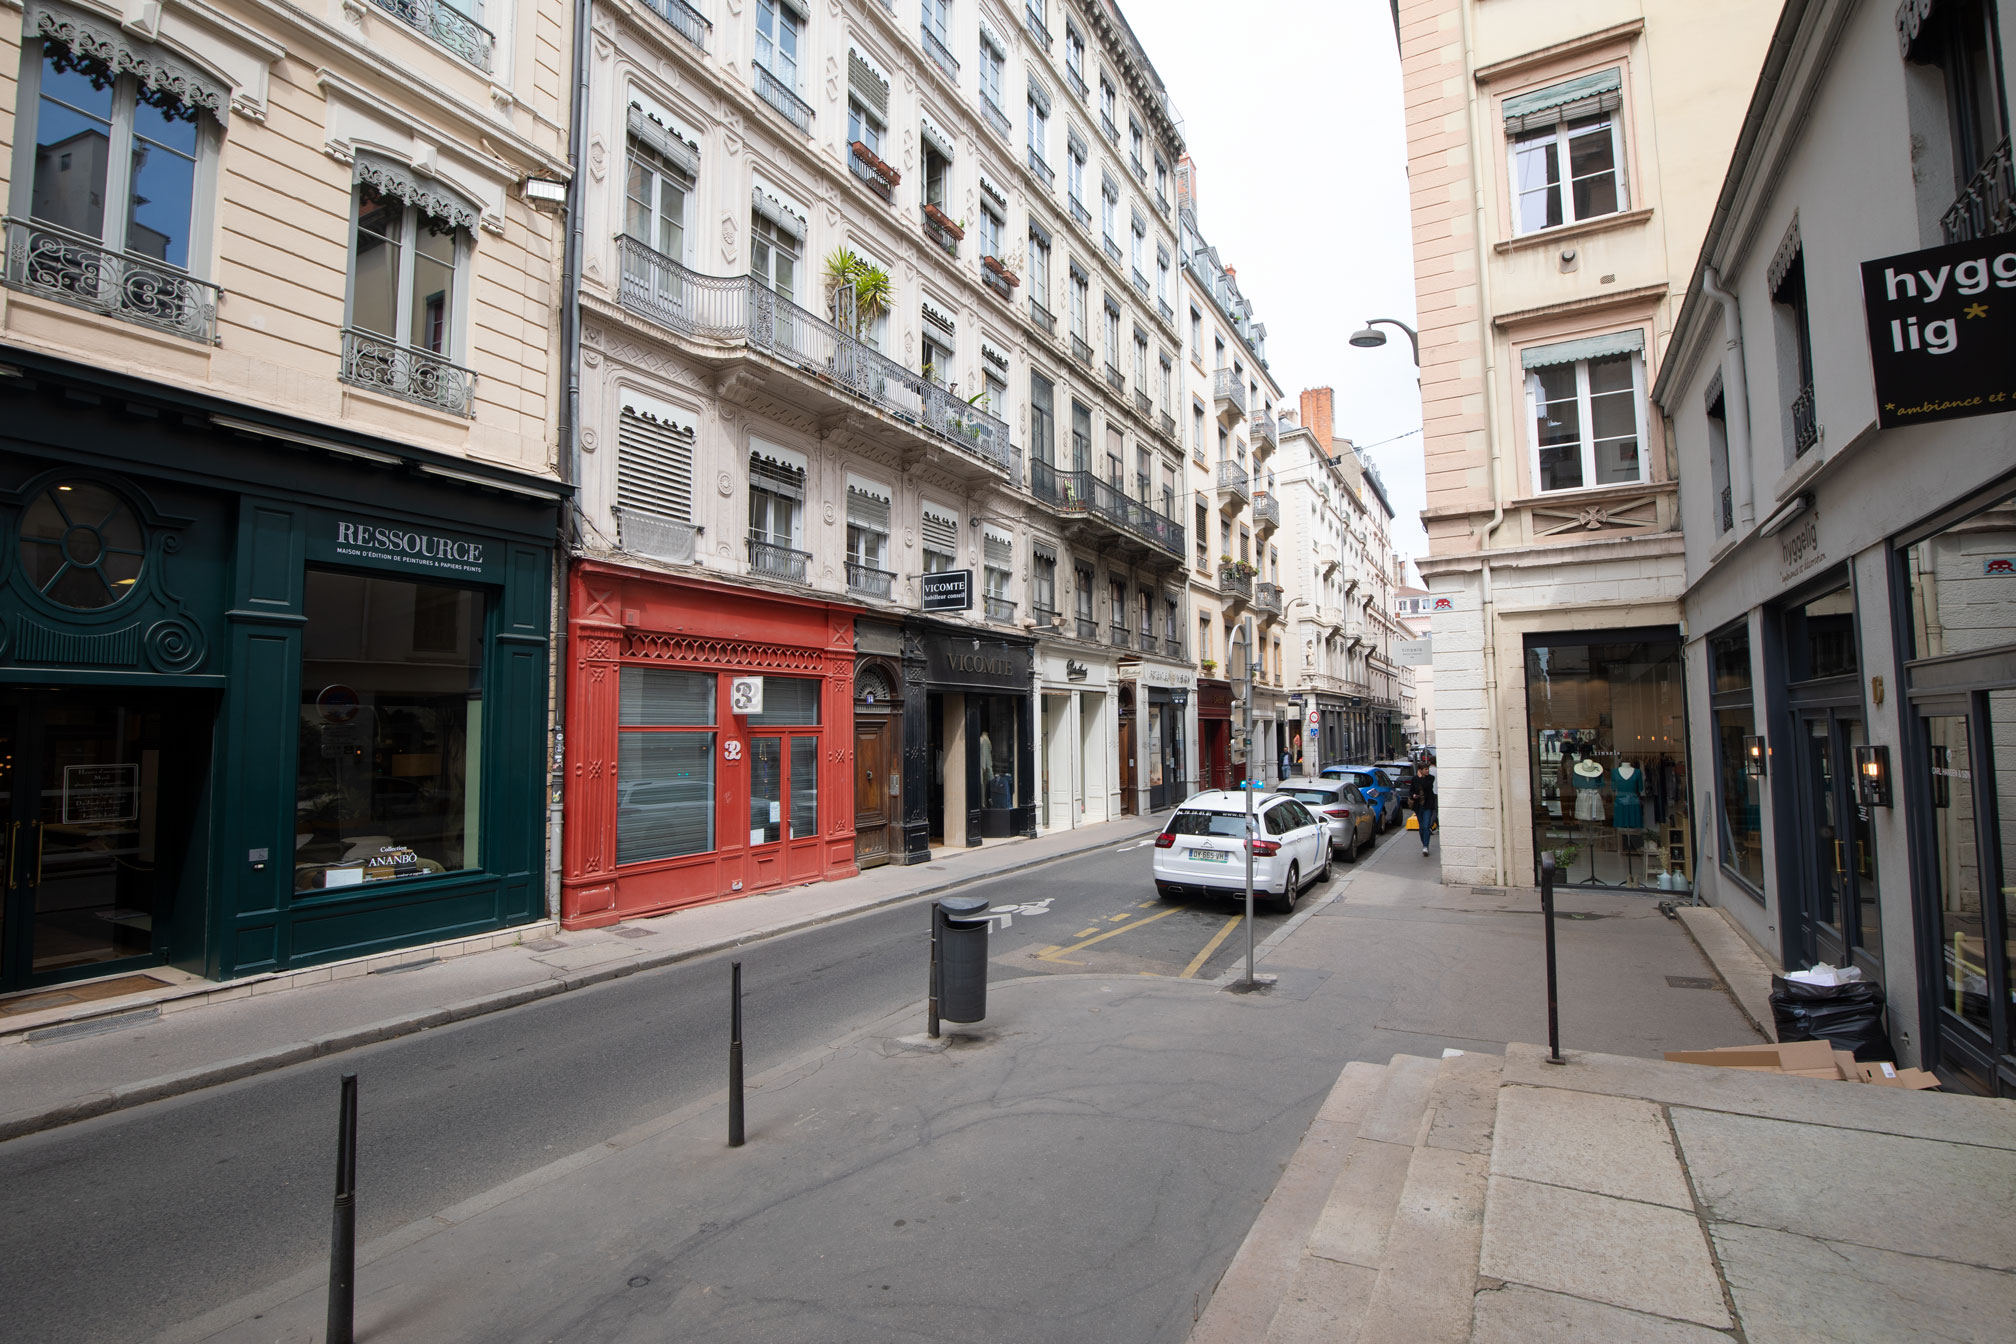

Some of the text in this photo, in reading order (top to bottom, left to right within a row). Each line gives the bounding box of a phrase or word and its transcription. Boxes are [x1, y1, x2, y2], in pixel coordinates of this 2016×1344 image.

[1988, 391, 2006, 403] et
[336, 521, 483, 563] RESSOURCE
[1781, 521, 1818, 567] hyggelig
[336, 547, 361, 556] MAISON
[362, 550, 392, 560] D'ÉDITION
[402, 556, 434, 566] PEINTURES
[440, 562, 462, 570] PAPIERS
[463, 565, 482, 573] PEINTS
[924, 581, 965, 593] VICOMTE
[924, 593, 947, 601] habilleur
[947, 653, 1013, 676] VICOMTE
[368, 852, 418, 867] ANANBÔ
